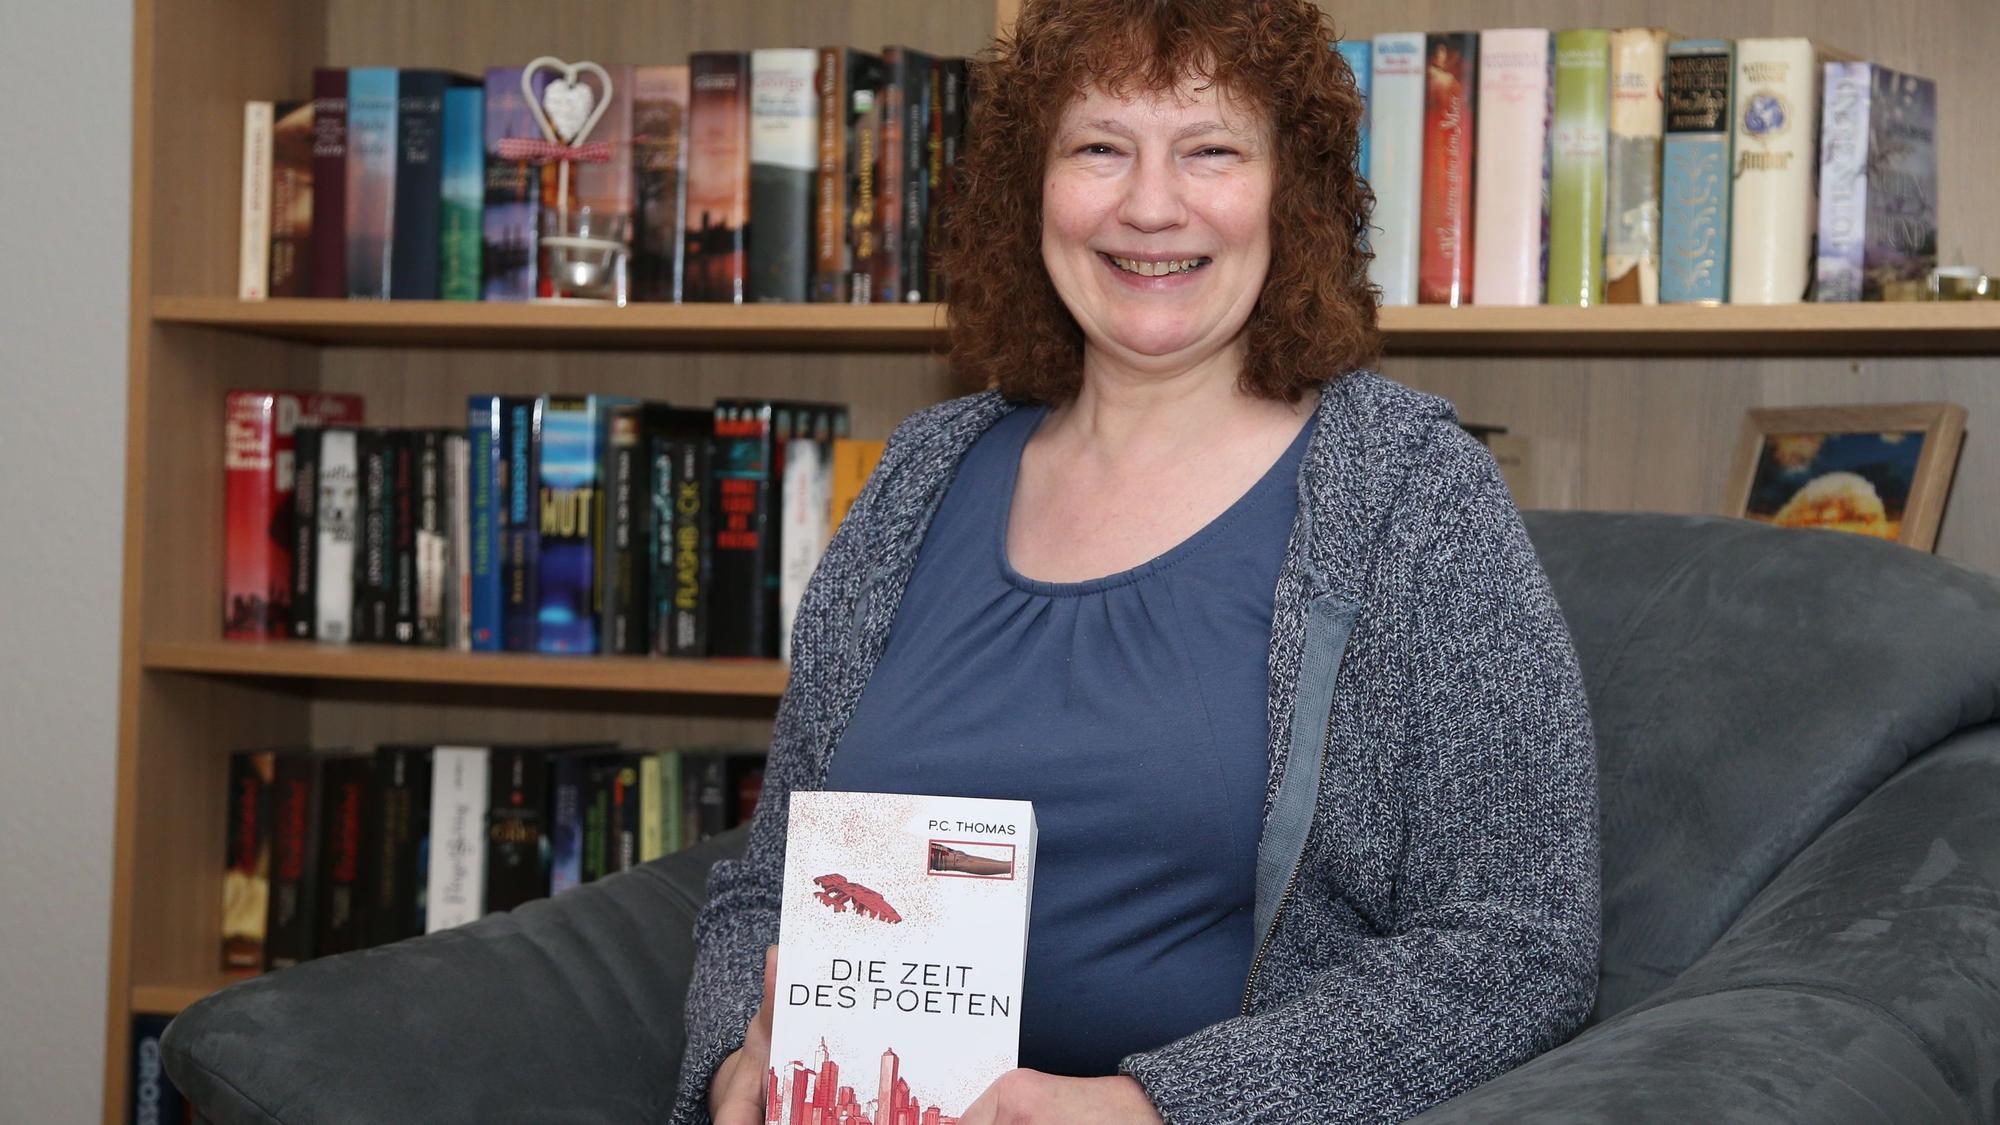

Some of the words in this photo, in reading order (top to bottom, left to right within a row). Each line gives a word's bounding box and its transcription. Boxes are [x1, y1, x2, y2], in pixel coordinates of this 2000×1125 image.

[539, 487, 593, 539] MUT
[928, 819, 951, 832] P.C.
[956, 821, 1017, 835] THOMAS
[831, 959, 887, 983] DIE
[899, 962, 973, 988] ZEIT
[789, 983, 857, 1009] DES
[872, 987, 1011, 1017] POETEN
